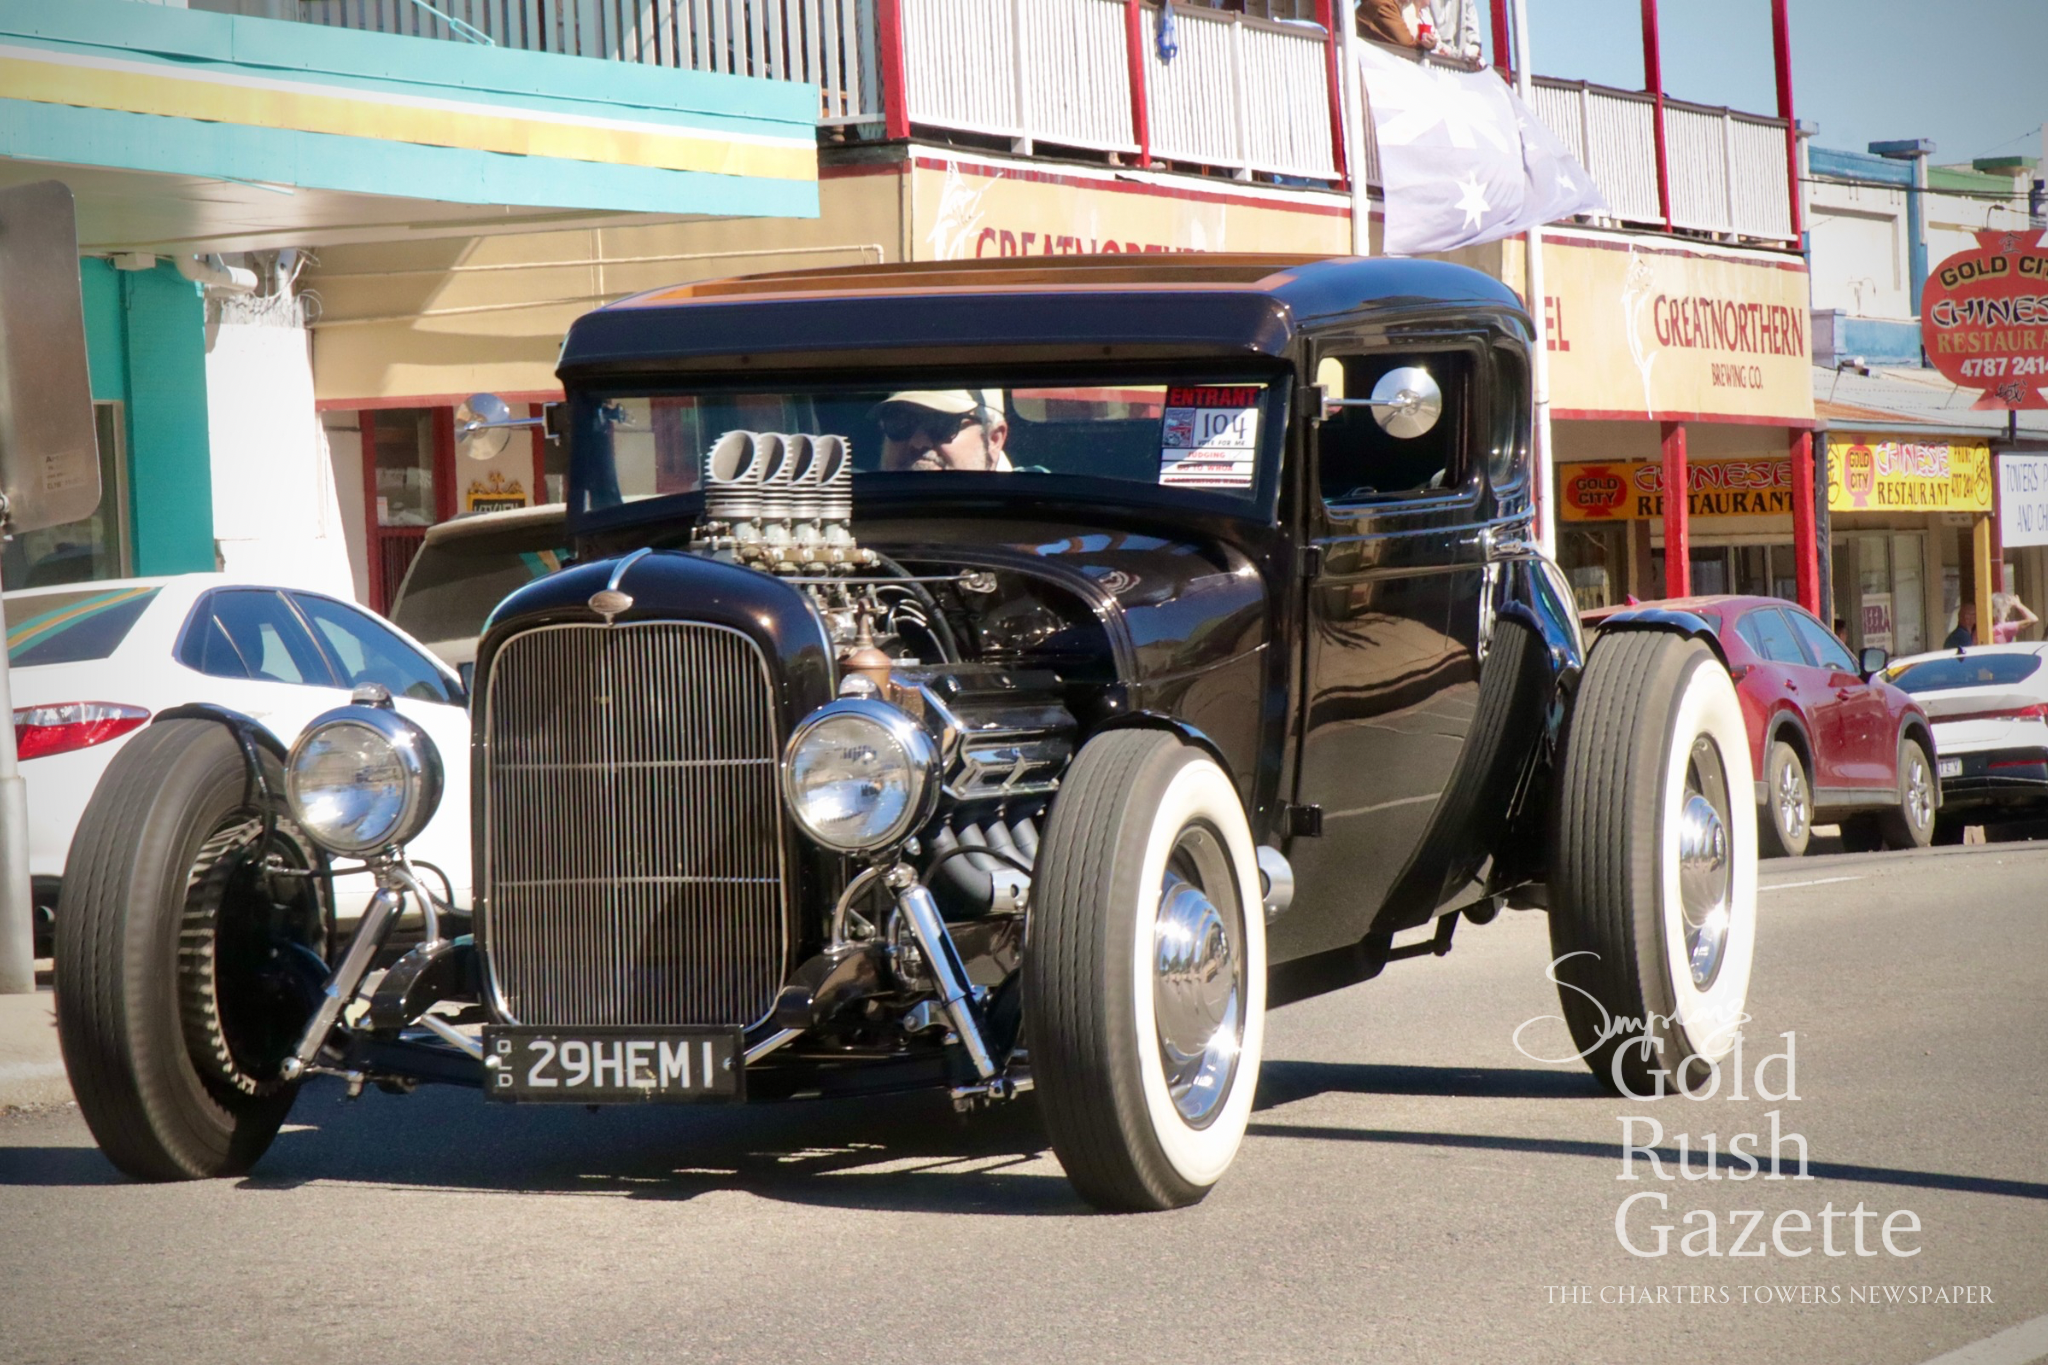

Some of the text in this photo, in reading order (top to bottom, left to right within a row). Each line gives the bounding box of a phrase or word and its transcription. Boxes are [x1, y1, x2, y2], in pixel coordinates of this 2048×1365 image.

[1940, 256, 2048, 289] GOLD CI
[1932, 295, 2048, 328] CHINES
[1937, 330, 2048, 354] RESTAUR
[1711, 363, 1763, 389] BREWING CO.
[1960, 357, 2008, 377] 4787
[1170, 387, 1258, 406] ENTRANT
[1203, 413, 1248, 440] 104
[1188, 451, 1226, 459] JUDGING
[1849, 451, 1869, 468] GOLD
[1875, 438, 1950, 478] CHINESE
[1576, 477, 1619, 491] GOLD
[1633, 461, 1792, 492] CNESE
[1850, 473, 1869, 490] CITY
[1578, 492, 1616, 506] CITY
[1637, 491, 1794, 516] RETAURANT
[1878, 481, 1949, 505] RESTAURANT
